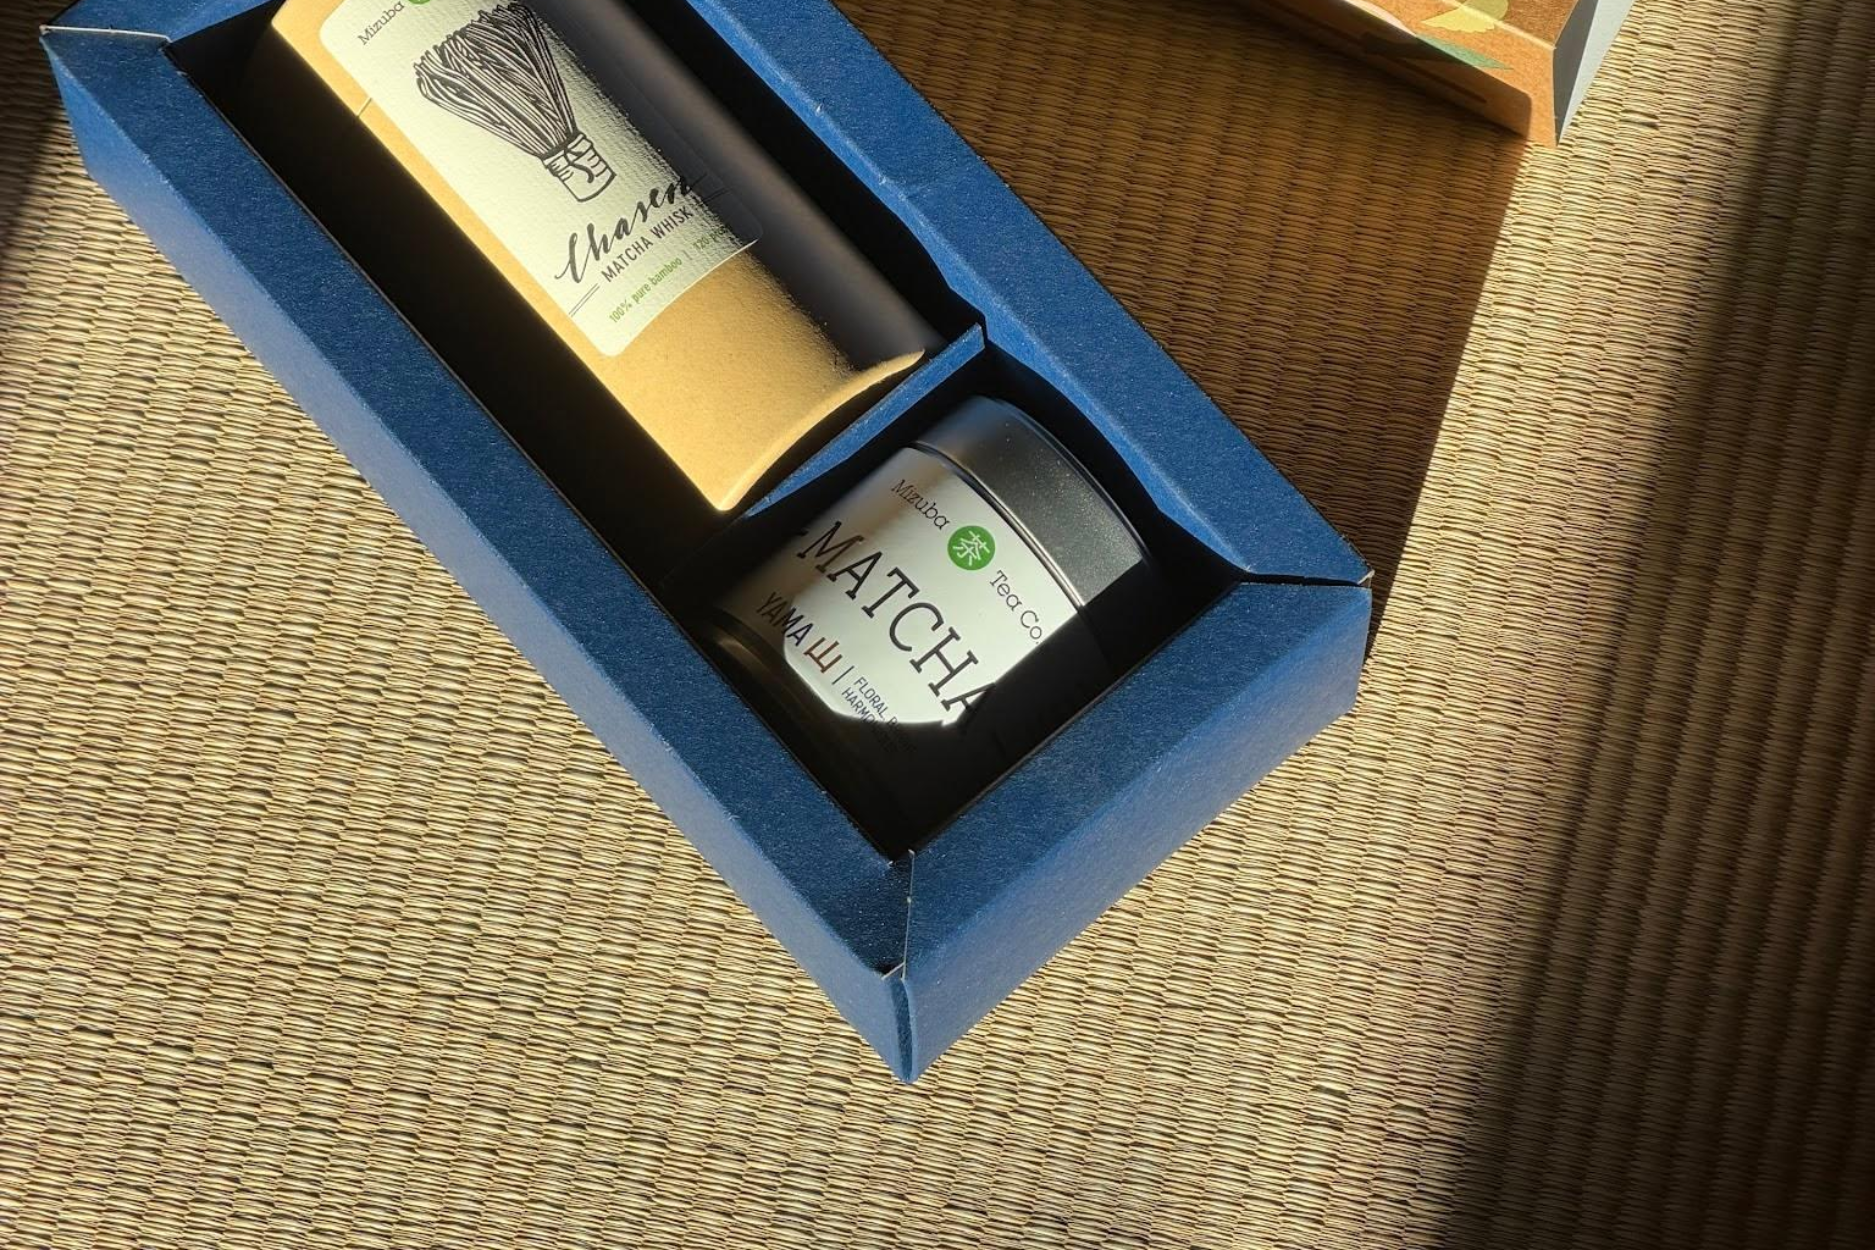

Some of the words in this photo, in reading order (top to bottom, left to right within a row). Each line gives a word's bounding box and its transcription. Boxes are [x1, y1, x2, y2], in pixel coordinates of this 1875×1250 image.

[357, 0, 405, 46] Mizuba
[554, 174, 706, 284] Chasen
[600, 236, 654, 283] MATCHA
[650, 205, 694, 240] WHISK
[609, 299, 634, 324] 100%
[631, 282, 651, 305] pure
[649, 257, 683, 286] bamboo
[890, 479, 950, 531] Mizuba
[989, 569, 1023, 612] Tea
[755, 592, 815, 647] YAMA
[796, 521, 997, 722] MATCHA
